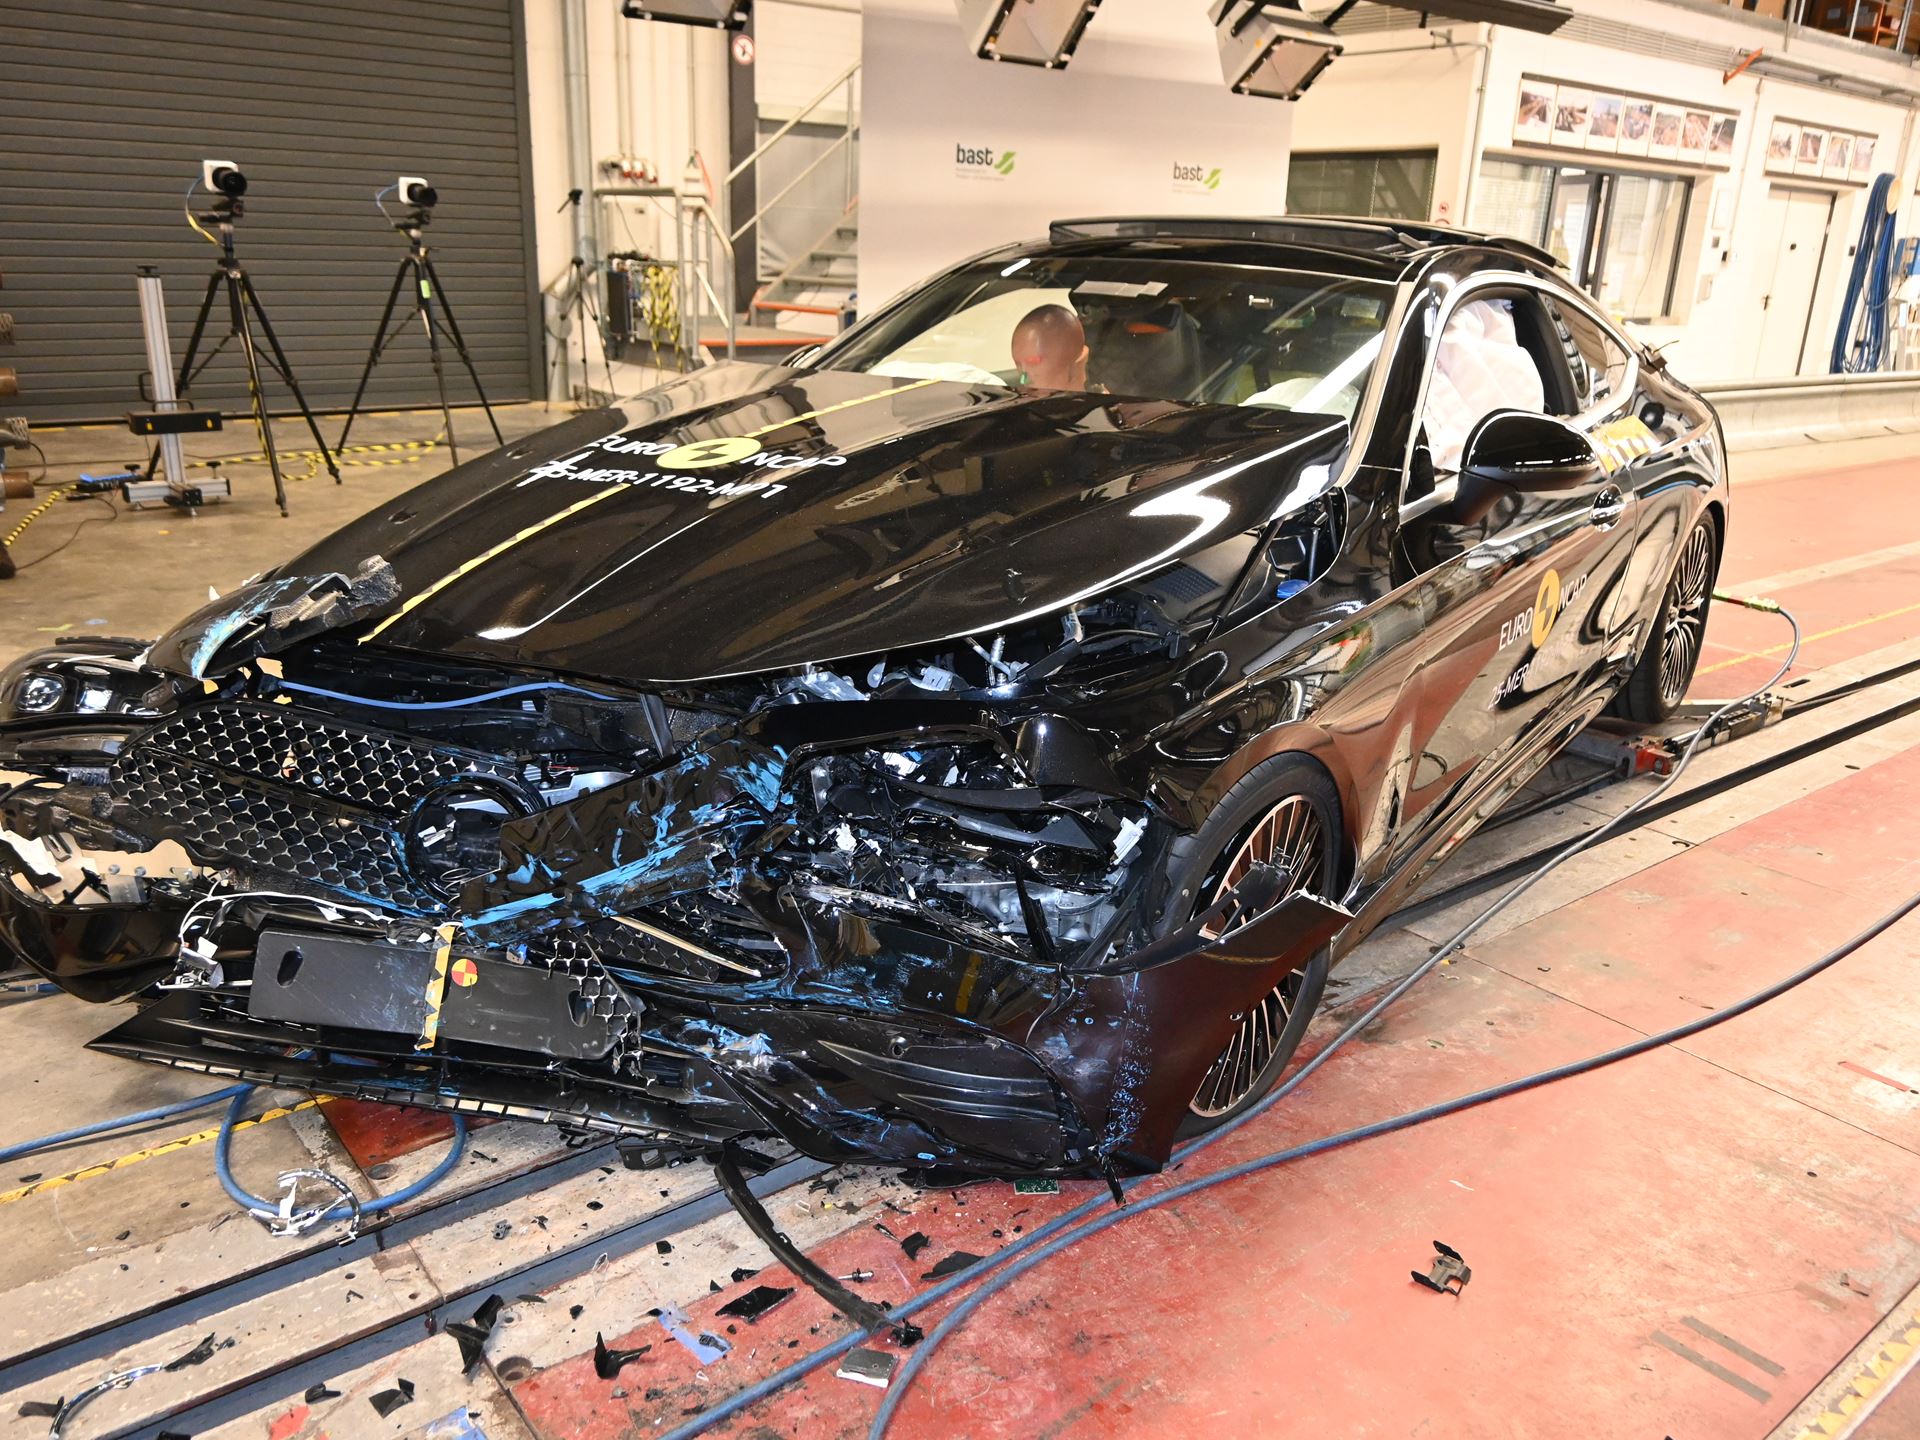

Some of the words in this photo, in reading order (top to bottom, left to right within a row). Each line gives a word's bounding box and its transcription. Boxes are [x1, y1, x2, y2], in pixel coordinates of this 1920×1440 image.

[956, 142, 994, 166] bast
[1173, 161, 1204, 182] bast
[743, 451, 847, 469] NCAP
[1499, 607, 1534, 651] EURO
[1558, 574, 1588, 612] NCAP
